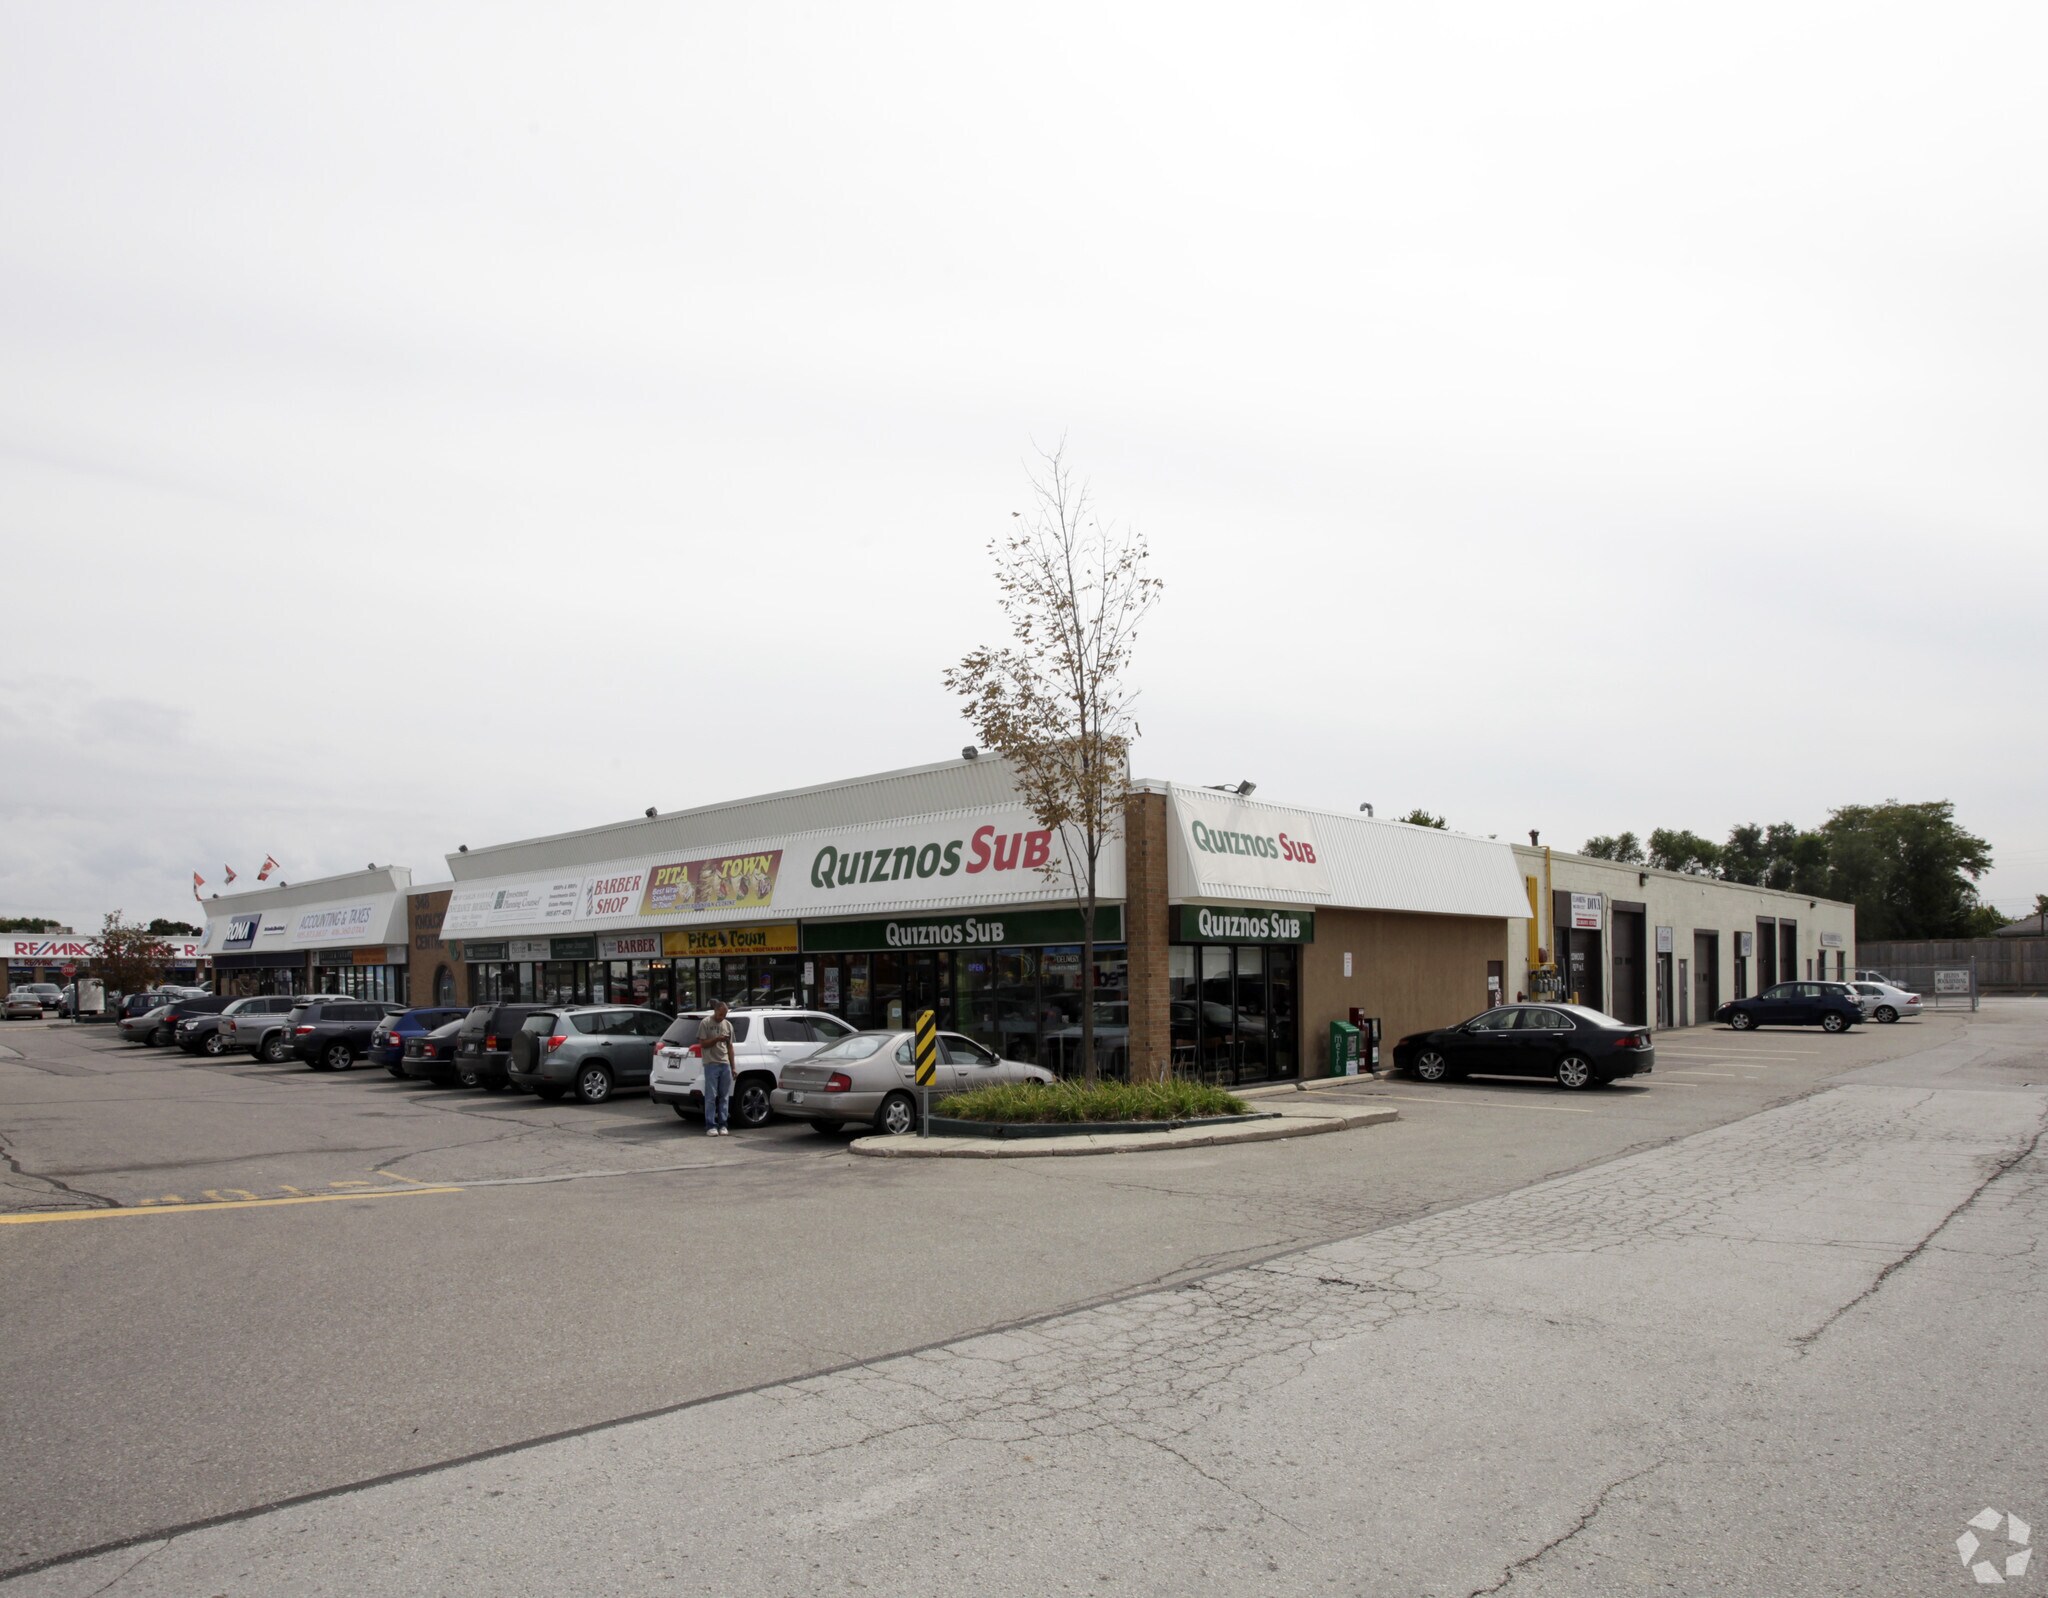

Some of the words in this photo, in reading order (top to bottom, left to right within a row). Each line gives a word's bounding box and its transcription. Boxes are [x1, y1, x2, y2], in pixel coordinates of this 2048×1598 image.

[1191, 820, 1279, 859] Quiznos
[1278, 832, 1316, 864] Sub
[811, 845, 963, 889] Quiznos
[965, 825, 1052, 874] Sub
[655, 866, 689, 886] PITA
[720, 855, 773, 880] TOWN
[594, 875, 642, 896] BARBER
[415, 894, 430, 910] 348
[595, 896, 629, 915] SHOP
[1587, 897, 1600, 910] DIVA
[299, 910, 342, 930] ACCOUNTING
[341, 911, 348, 926] &
[349, 907, 372, 925] TAXES
[1198, 908, 1269, 938] Quiznos
[1271, 912, 1301, 938] Sub
[226, 920, 252, 941] RONA
[688, 932, 717, 949] Pita
[729, 930, 767, 948] Town
[885, 922, 963, 947] Quiznos
[965, 917, 1004, 943] Sub
[14, 941, 94, 956] RE/MAX
[617, 938, 656, 953] BARBER
[968, 963, 983, 971] OPEN
[1056, 955, 1079, 963] DELIVERY
